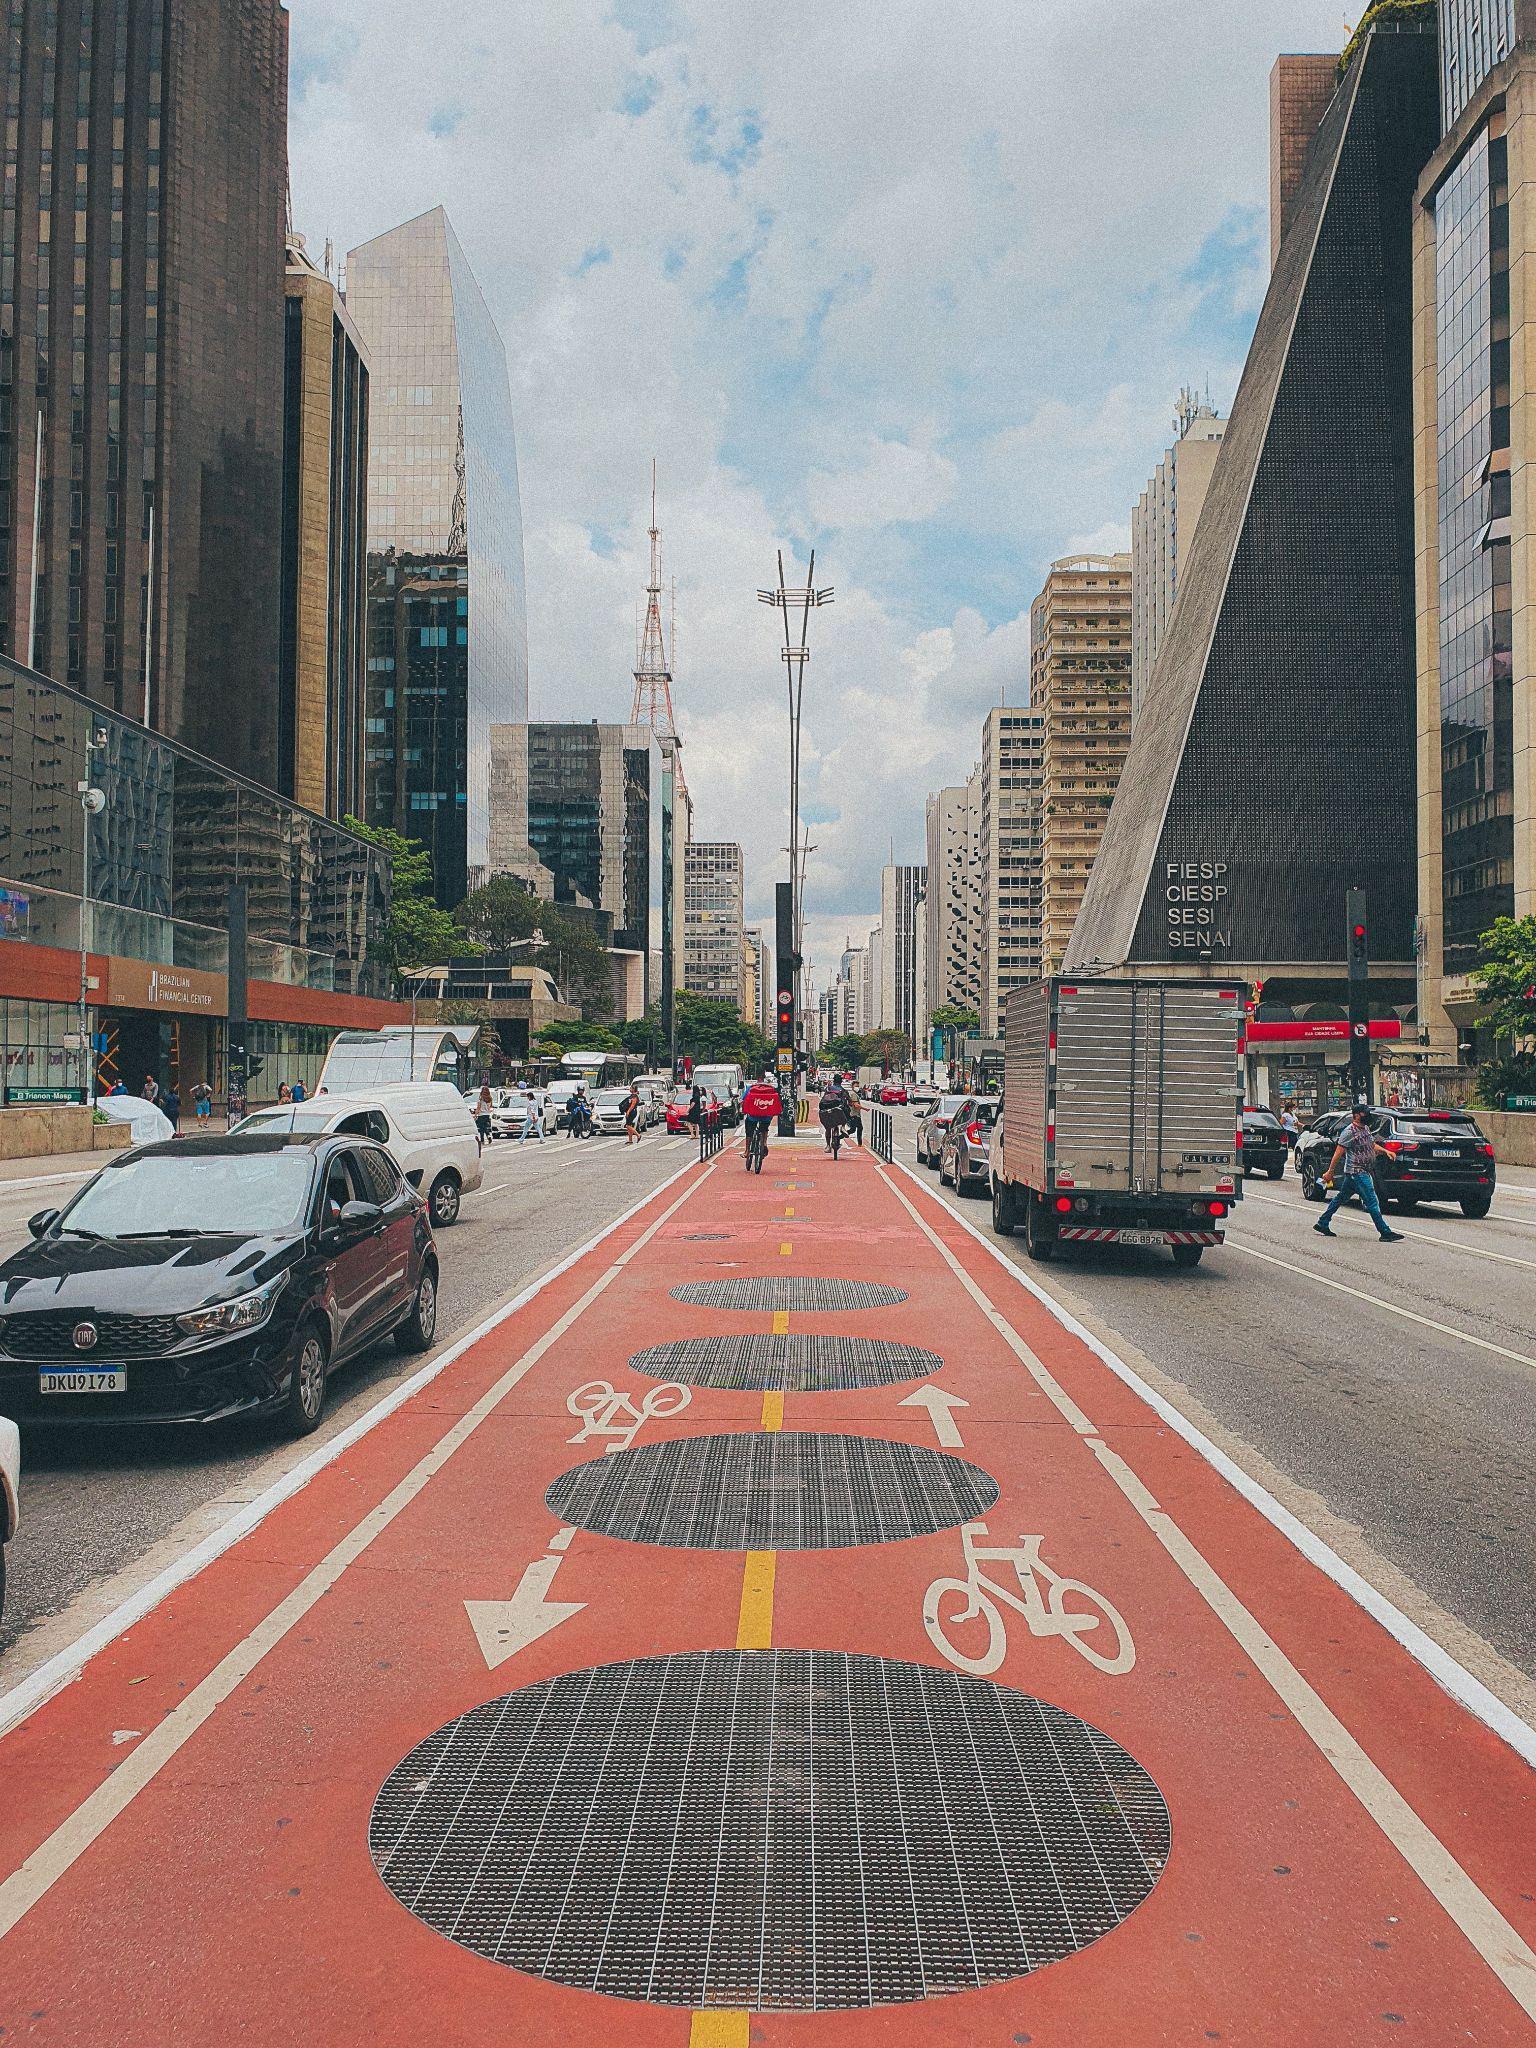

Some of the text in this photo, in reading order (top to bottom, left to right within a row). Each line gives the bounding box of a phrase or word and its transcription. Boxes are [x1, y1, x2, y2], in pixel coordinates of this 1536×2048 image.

[1166, 862, 1228, 879] FIESP
[1166, 885, 1228, 902] CIESP
[1168, 908, 1214, 925] SESI
[1168, 931, 1231, 947] SENAI
[159, 974, 190, 988] BRAZILIAN
[159, 990, 212, 1006] FINANCIAL CENTER
[77, 1330, 92, 1343] FIAT
